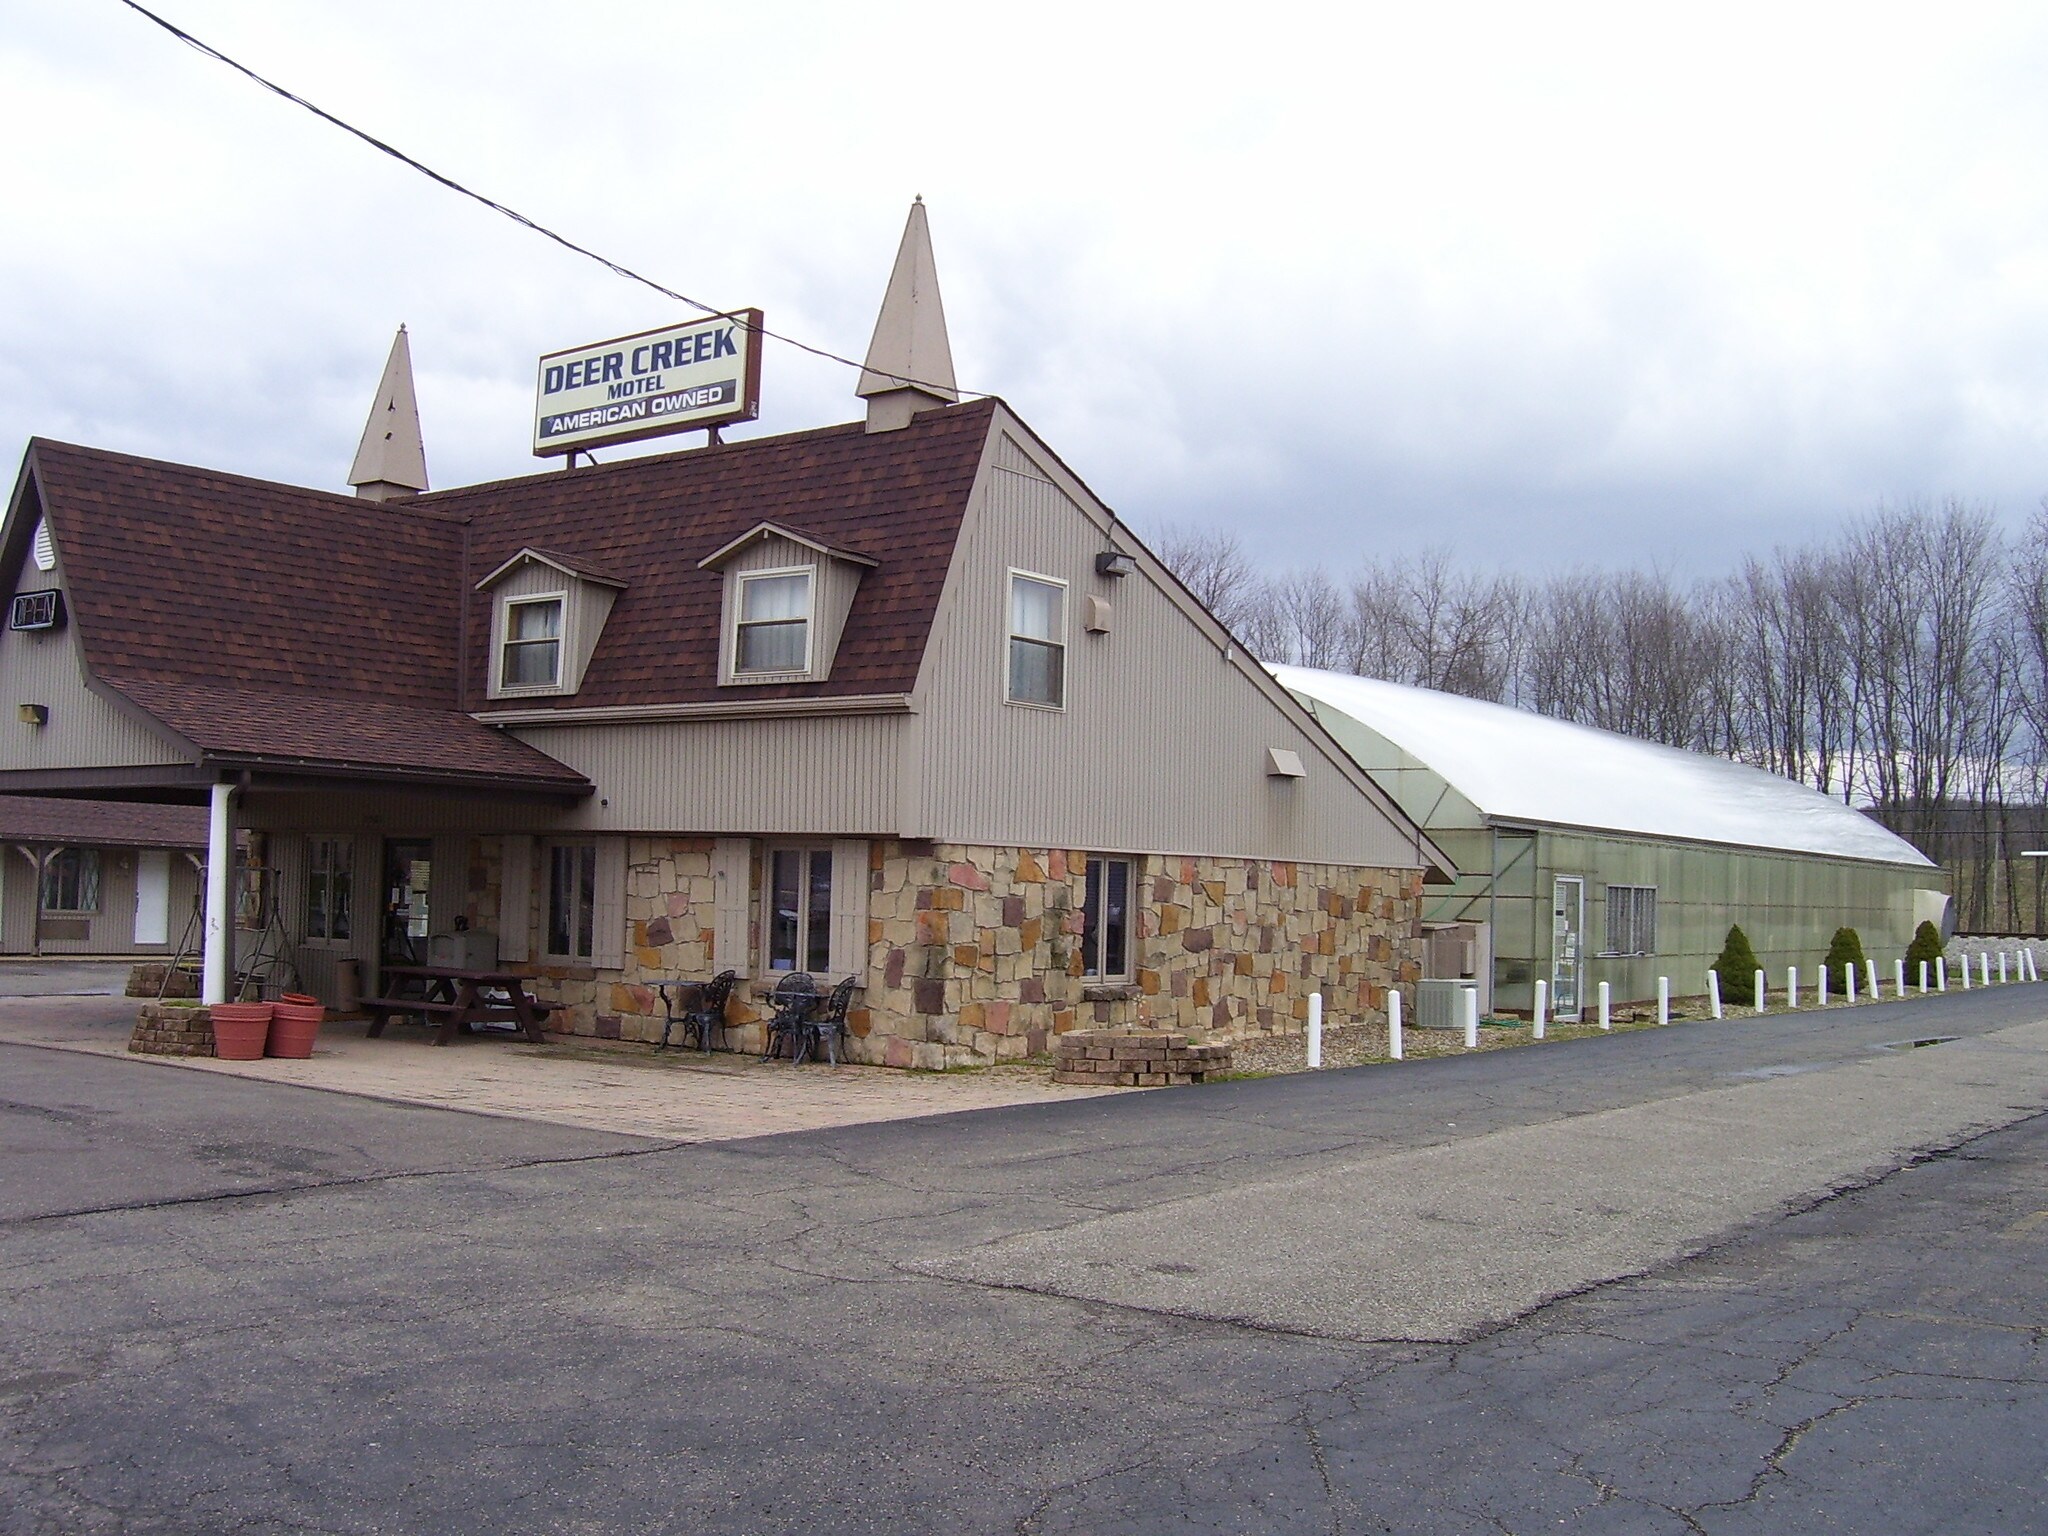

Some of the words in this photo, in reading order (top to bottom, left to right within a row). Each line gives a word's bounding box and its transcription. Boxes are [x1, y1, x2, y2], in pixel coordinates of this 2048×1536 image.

[544, 352, 623, 395] DEER
[631, 326, 737, 376] CREEK
[607, 375, 665, 400] MOTEL
[551, 402, 645, 433] AMERICAN
[651, 387, 723, 413] OWNED
[14, 595, 52, 625] OPEN
